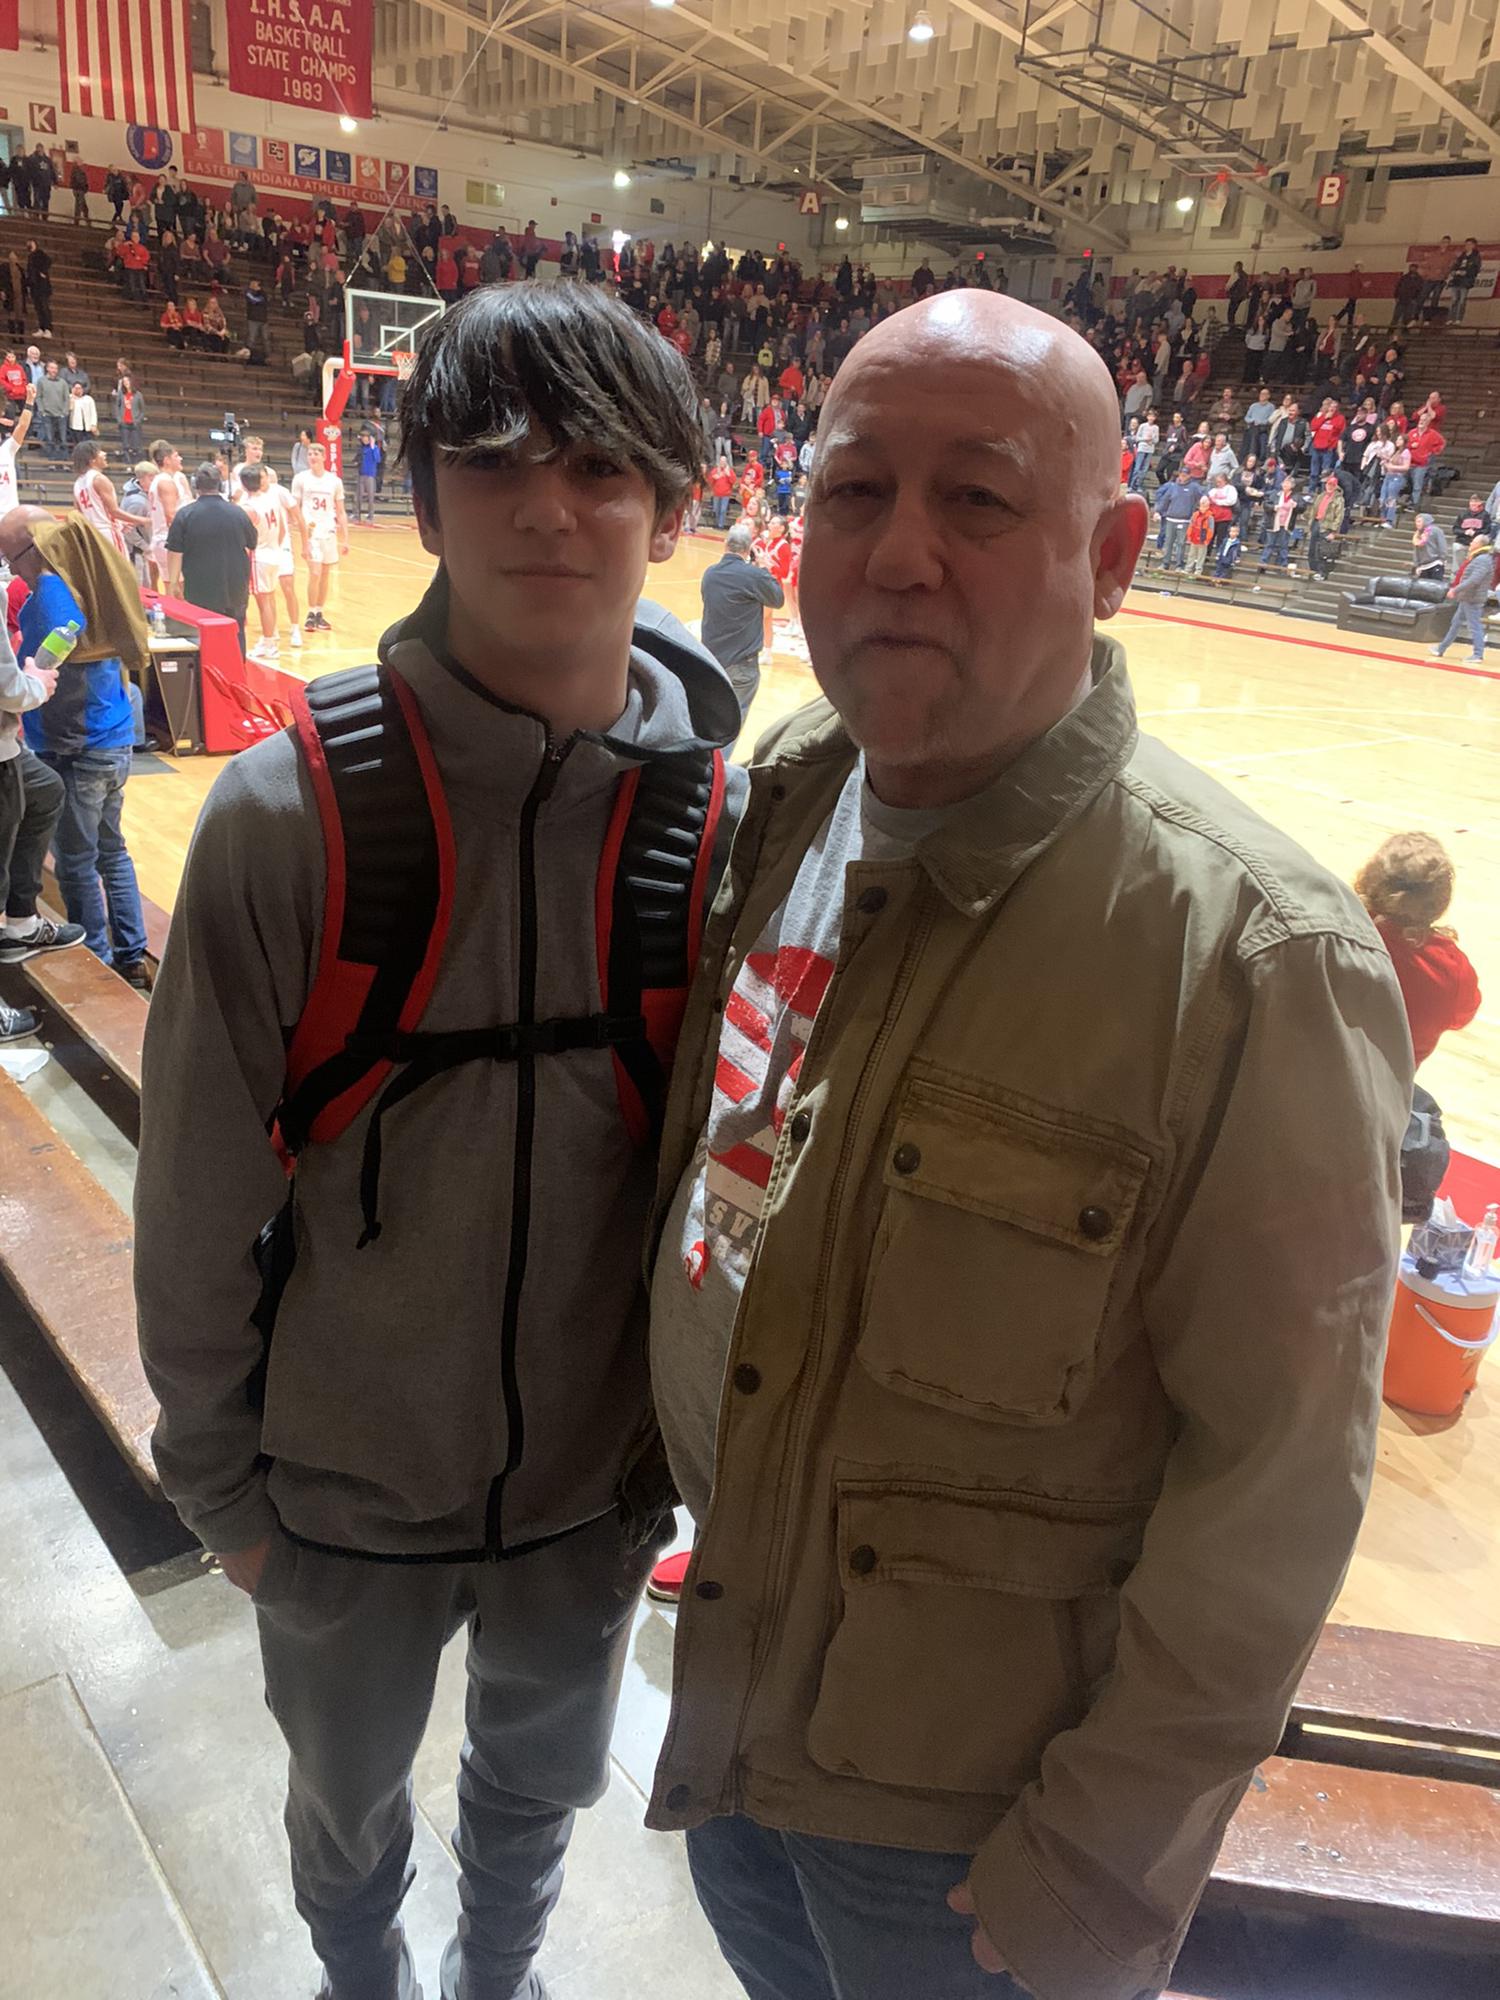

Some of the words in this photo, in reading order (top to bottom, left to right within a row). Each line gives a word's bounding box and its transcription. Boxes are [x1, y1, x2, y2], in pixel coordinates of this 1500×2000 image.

[255, 20, 346, 58] BASKETBALL
[247, 44, 290, 72] STATE
[300, 55, 356, 85] CHAMPS
[283, 77, 323, 102] 1983
[33, 104, 53, 132] K
[249, 171, 300, 189] INDIANA
[304, 180, 359, 200] ATHLETIC
[1320, 176, 1341, 205] B
[800, 192, 820, 214] A
[312, 497, 326, 511] 34
[265, 508, 277, 530] 14
